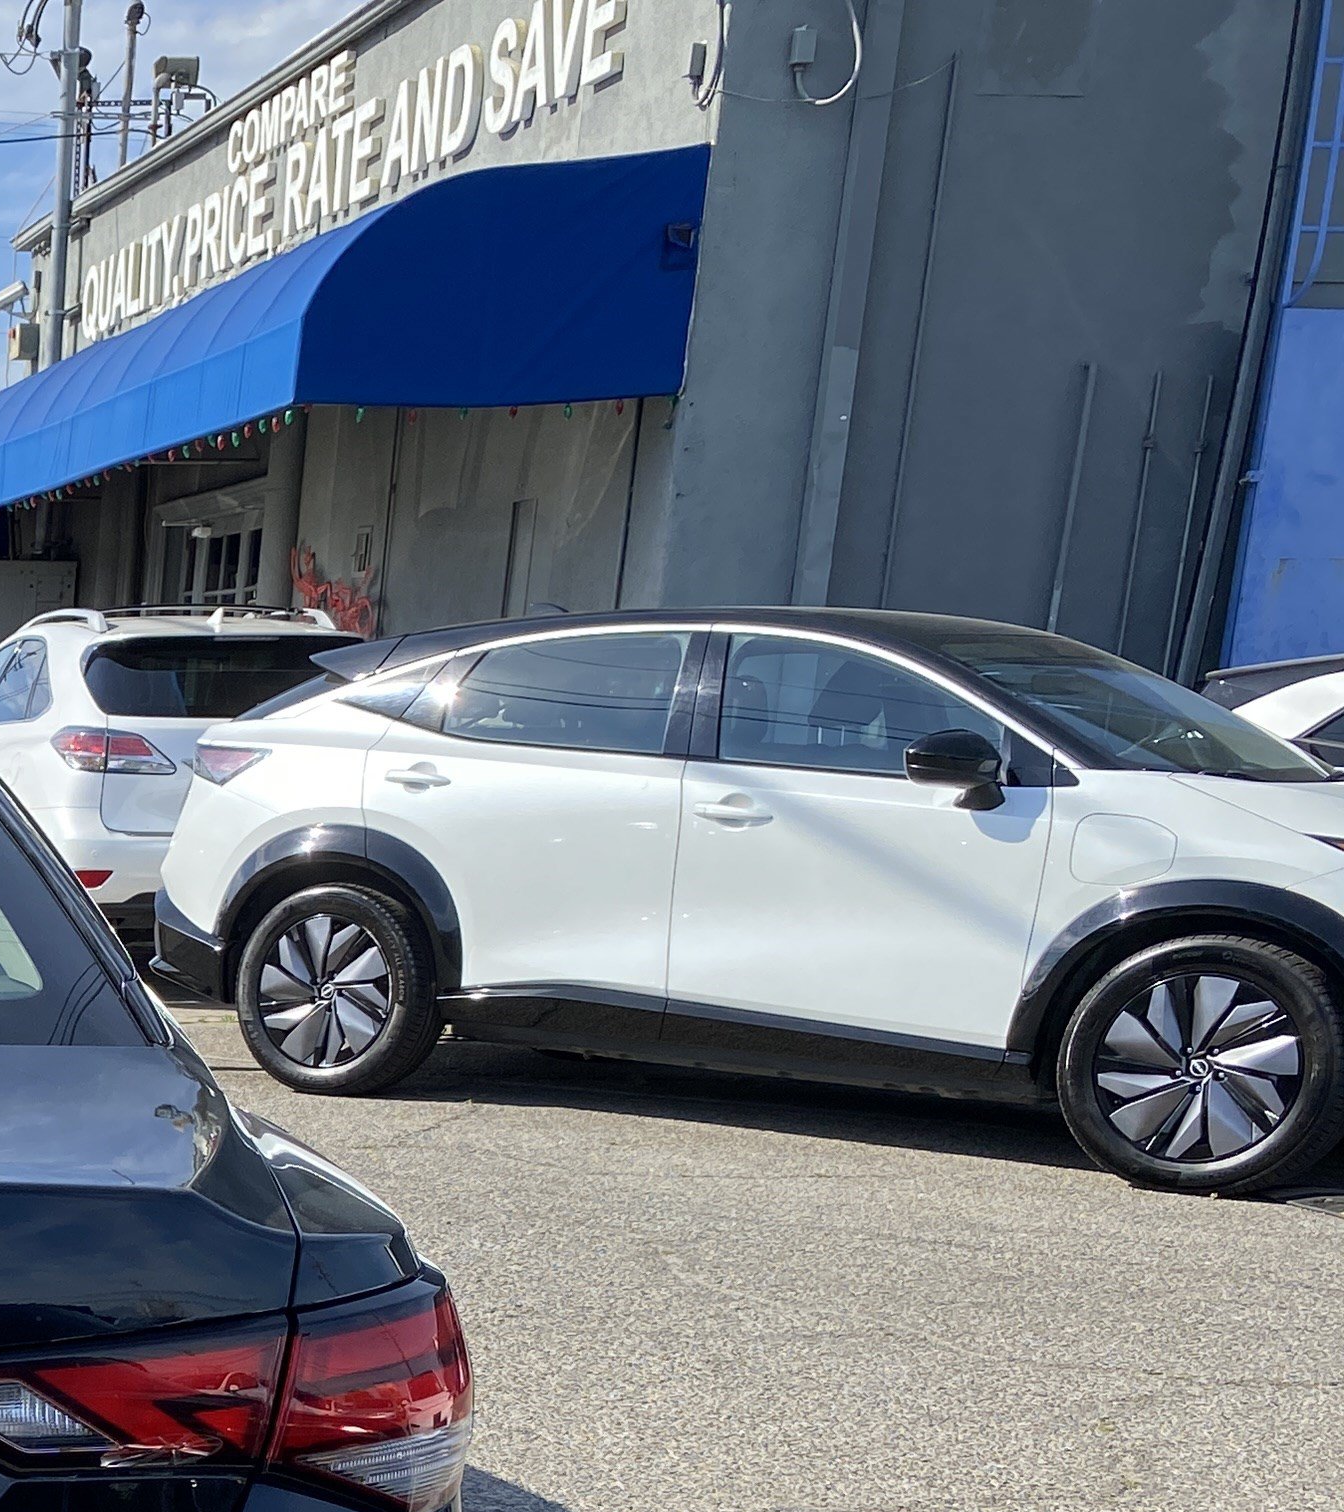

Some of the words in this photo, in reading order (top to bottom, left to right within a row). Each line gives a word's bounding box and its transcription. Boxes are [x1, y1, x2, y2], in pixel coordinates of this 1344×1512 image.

[228, 49, 357, 173] COMPARE
[283, 97, 386, 240] RATE
[381, 43, 482, 188] AND
[485, 0, 627, 136] SAVE
